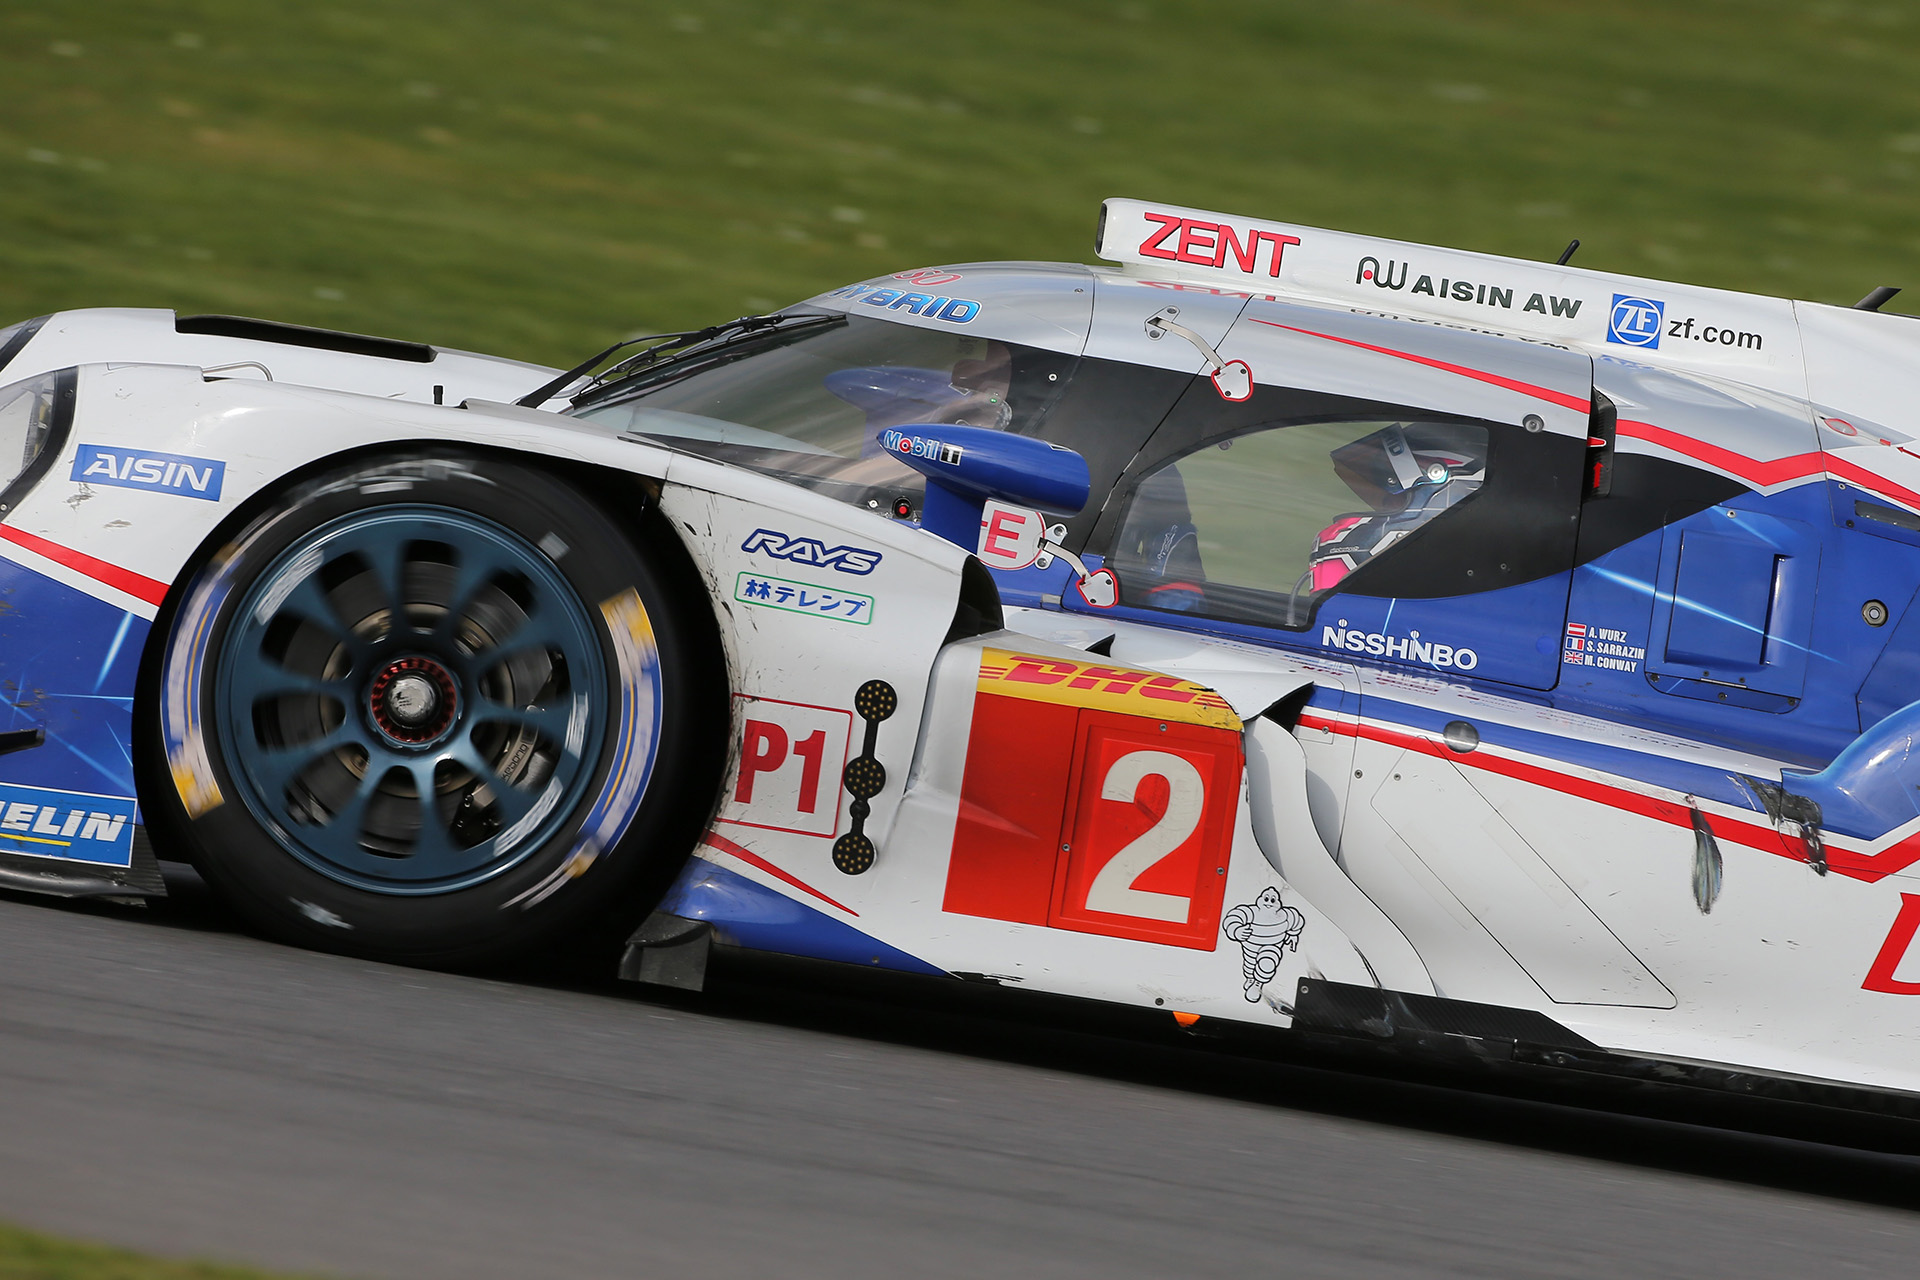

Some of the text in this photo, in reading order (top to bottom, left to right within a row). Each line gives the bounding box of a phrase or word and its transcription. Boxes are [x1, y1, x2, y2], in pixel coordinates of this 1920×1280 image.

[1139, 211, 1301, 278] ZENT
[1411, 274, 1514, 309] AISIN
[1523, 293, 1583, 319] AW
[1615, 303, 1659, 337] ZF
[1668, 317, 1763, 350] zf.com
[884, 430, 940, 461] Mobil
[82, 452, 214, 492] AISIN
[741, 528, 883, 576] RAYS
[744, 578, 867, 616] 林テレンプ
[1586, 640, 1645, 660] S. SARRAZIN
[1588, 626, 1627, 643] A. WURZ
[1003, 655, 1198, 704] DHL
[1584, 654, 1638, 673] M. CONWAY
[502, 743, 529, 782] kebono
[734, 718, 827, 814] P1
[0, 801, 128, 842] ELIN
[1085, 750, 1205, 924] 2
